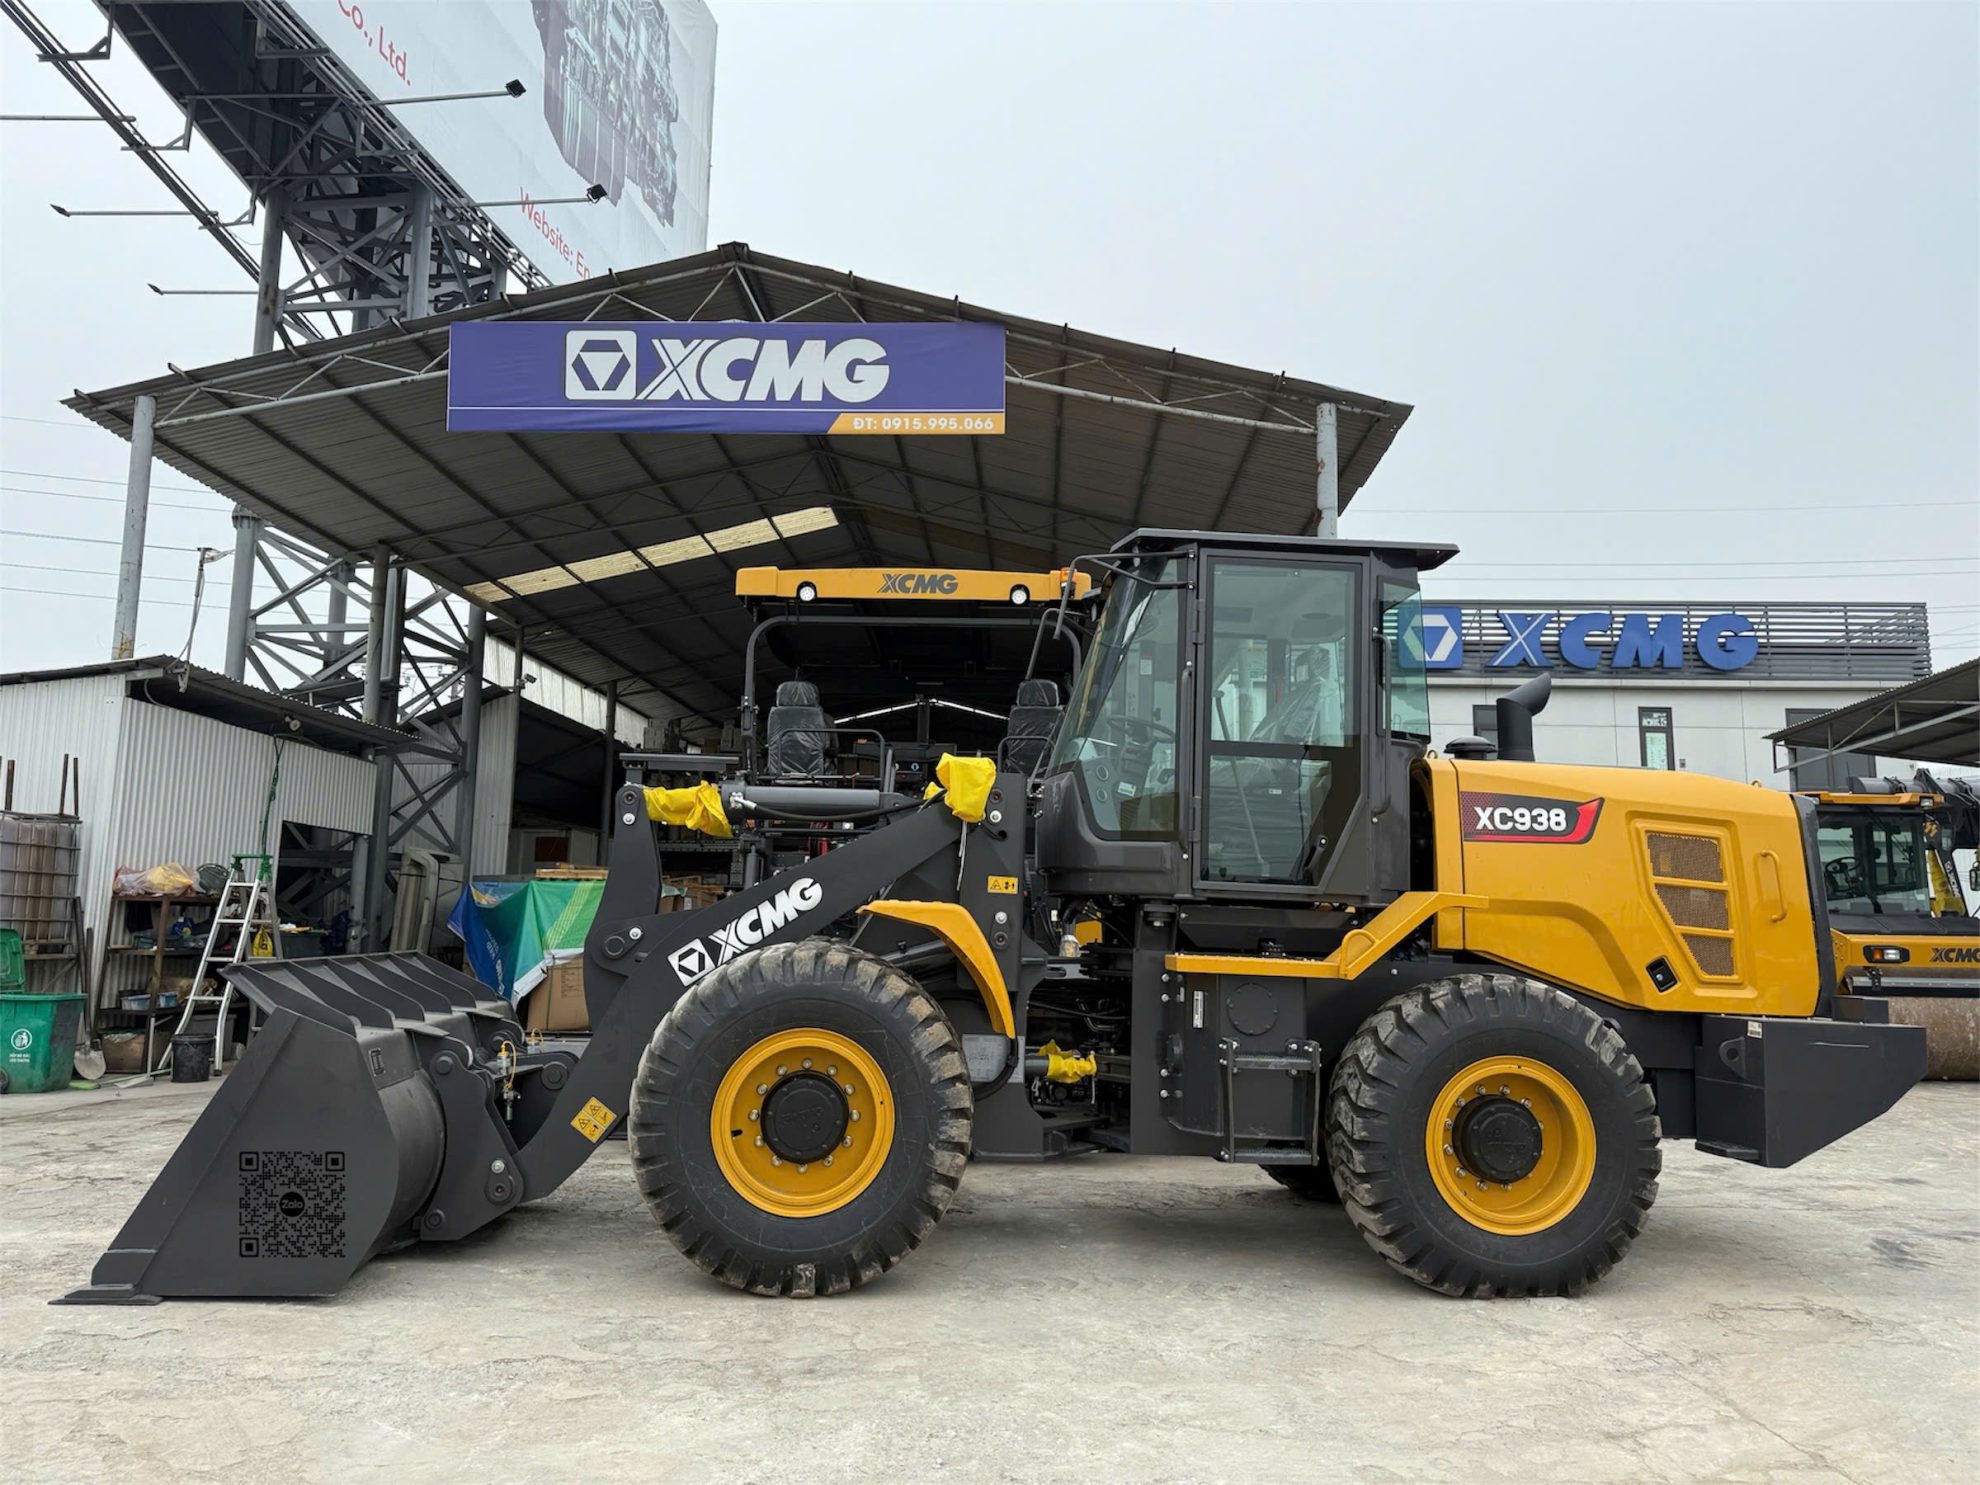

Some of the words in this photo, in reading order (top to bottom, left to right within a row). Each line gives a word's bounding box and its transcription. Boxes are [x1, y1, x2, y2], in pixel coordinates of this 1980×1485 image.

[379, 25, 411, 86] Ltd.
[519, 186, 574, 266] Website:
[635, 338, 890, 403] XCMG
[853, 417, 877, 430] ĐT:
[882, 417, 994, 430] 0915.995.066
[877, 573, 958, 595] XCMG
[1484, 612, 1759, 671] XCMG
[1473, 806, 1567, 832] XC938
[708, 877, 823, 967] XCMG
